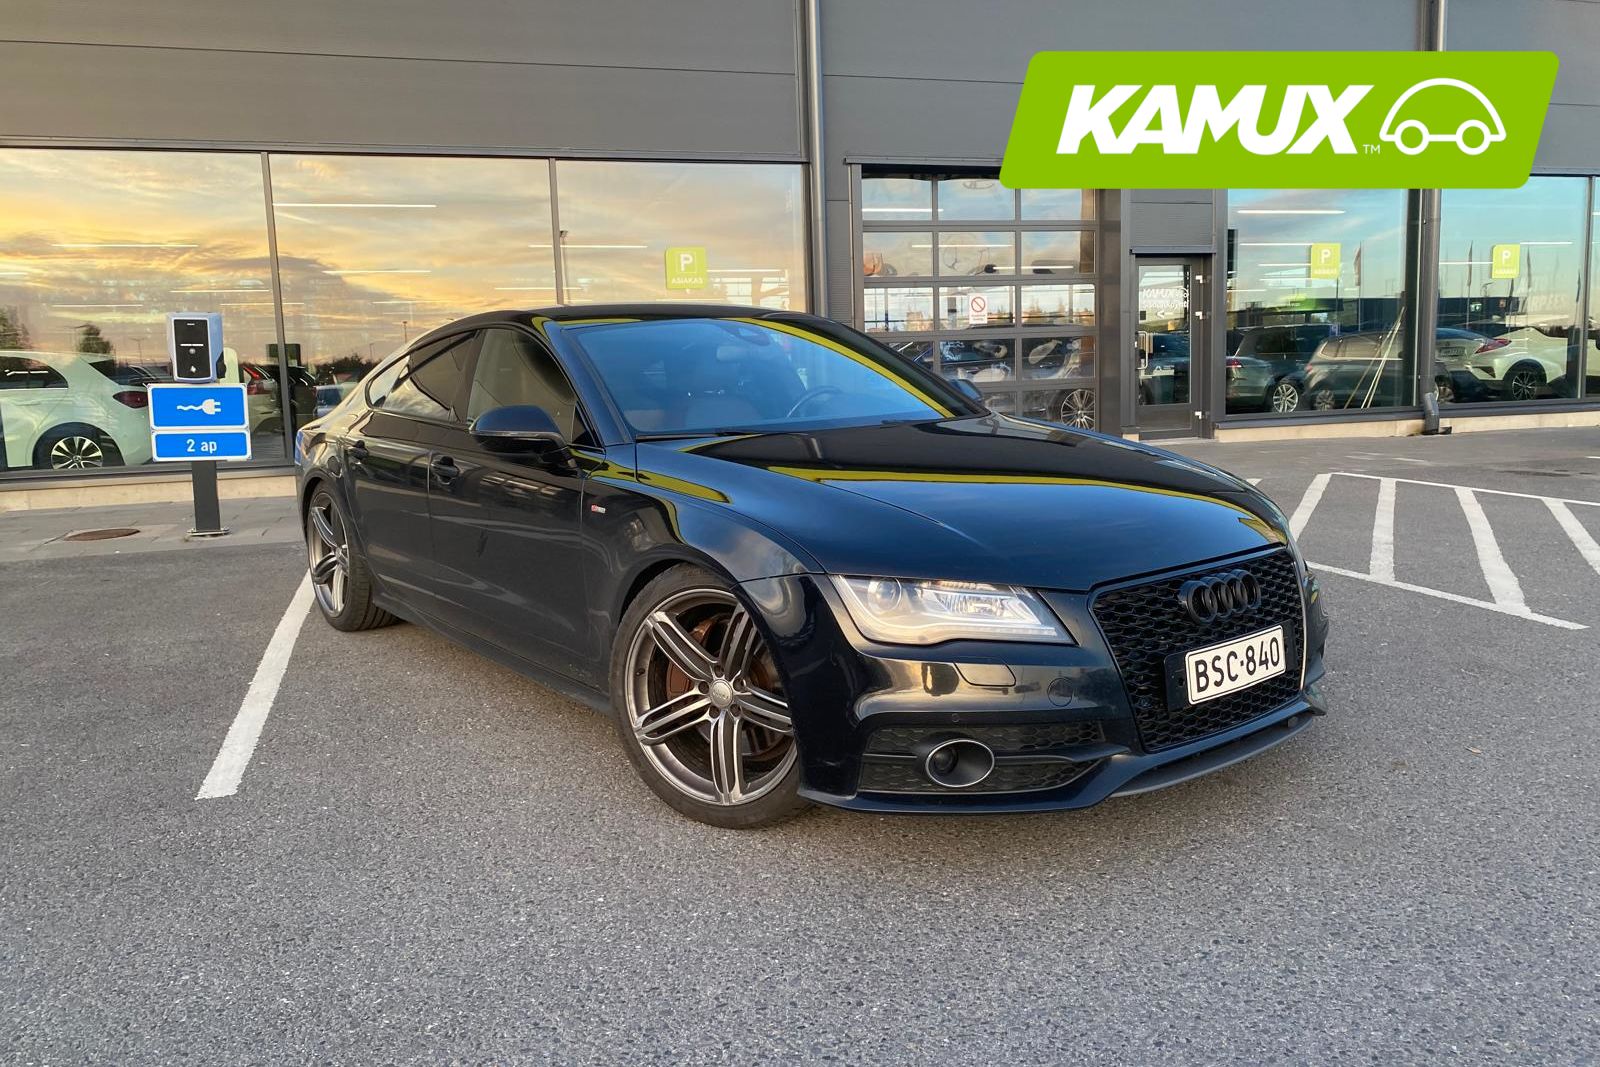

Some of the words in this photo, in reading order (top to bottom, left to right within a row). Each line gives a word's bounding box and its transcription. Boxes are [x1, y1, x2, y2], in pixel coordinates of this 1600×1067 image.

[680, 253, 693, 272] P
[1320, 249, 1331, 264] P
[1502, 250, 1511, 265] P
[186, 438, 196, 452] 2
[200, 441, 218, 454] ap
[1194, 636, 1280, 694] BSC-840
